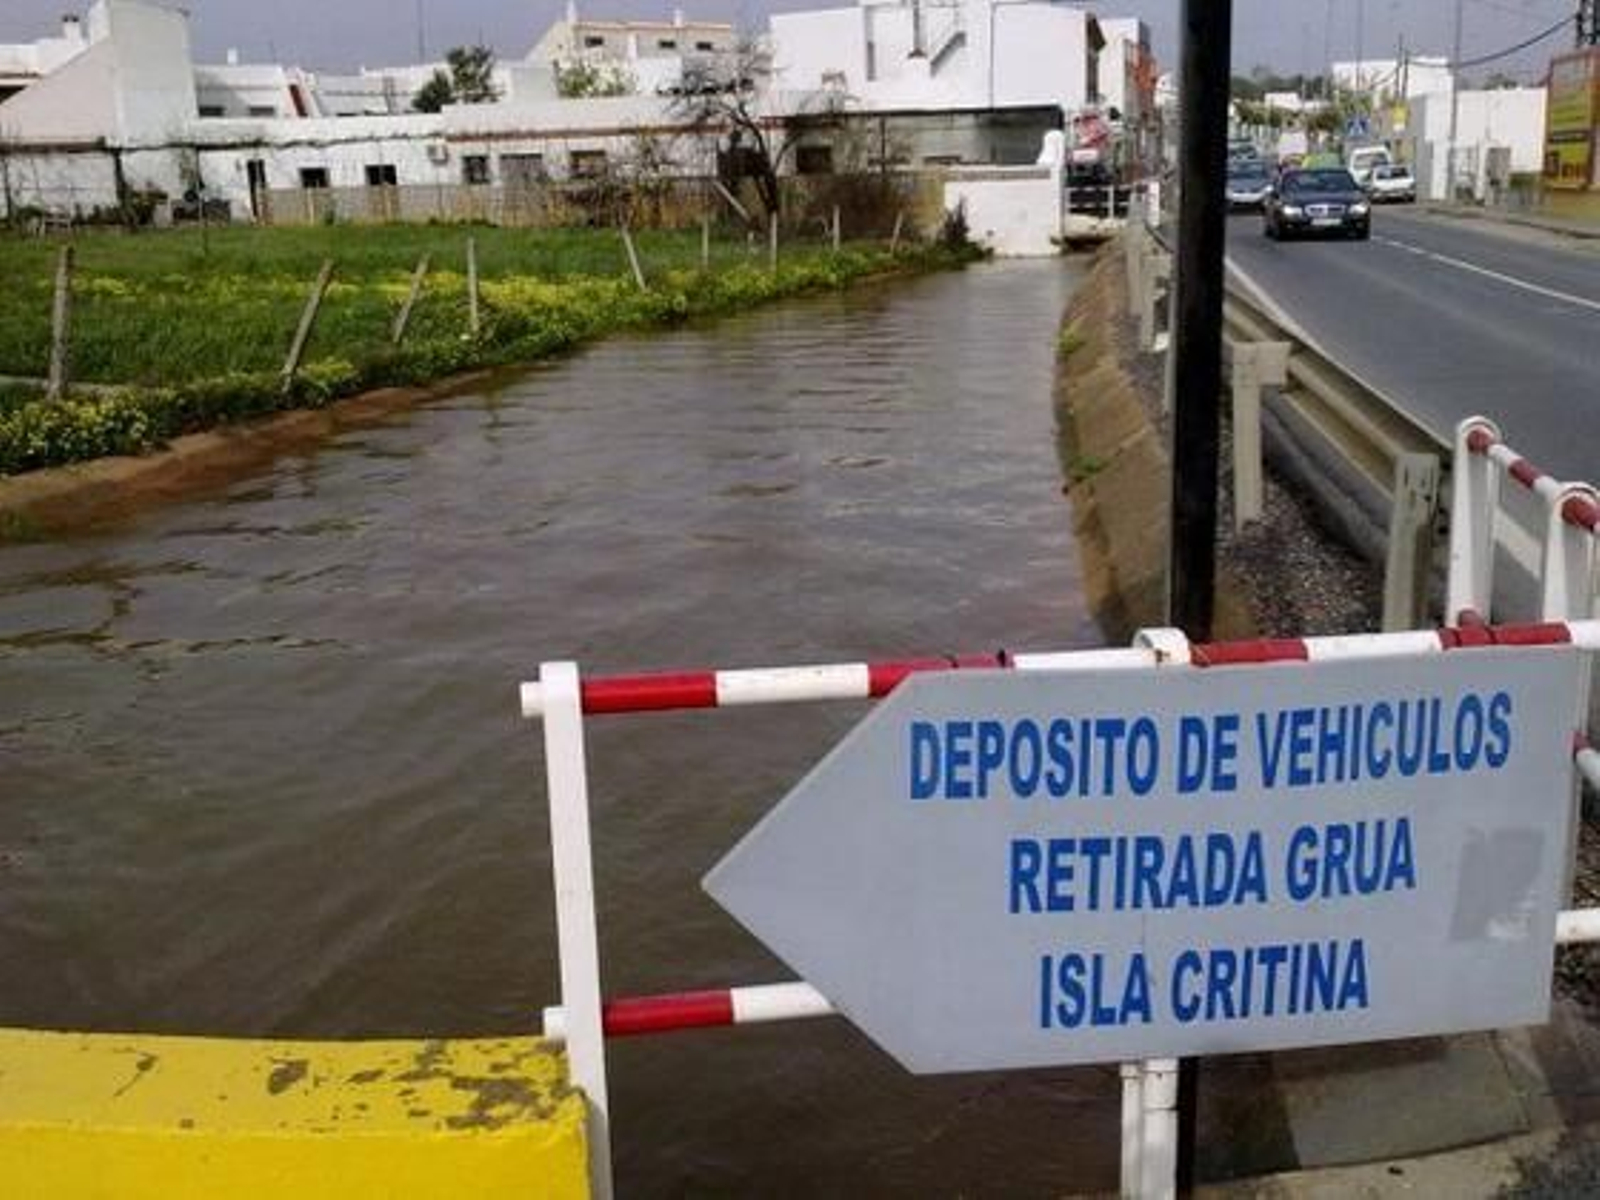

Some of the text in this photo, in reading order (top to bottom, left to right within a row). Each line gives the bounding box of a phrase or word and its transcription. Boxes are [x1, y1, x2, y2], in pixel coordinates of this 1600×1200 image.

[909, 691, 1512, 800] DEPOSITO DE VEHICULOS
[1009, 817, 1417, 914] RETIRADA GRUA
[1041, 939, 1368, 1029] ISLA CRITINA
